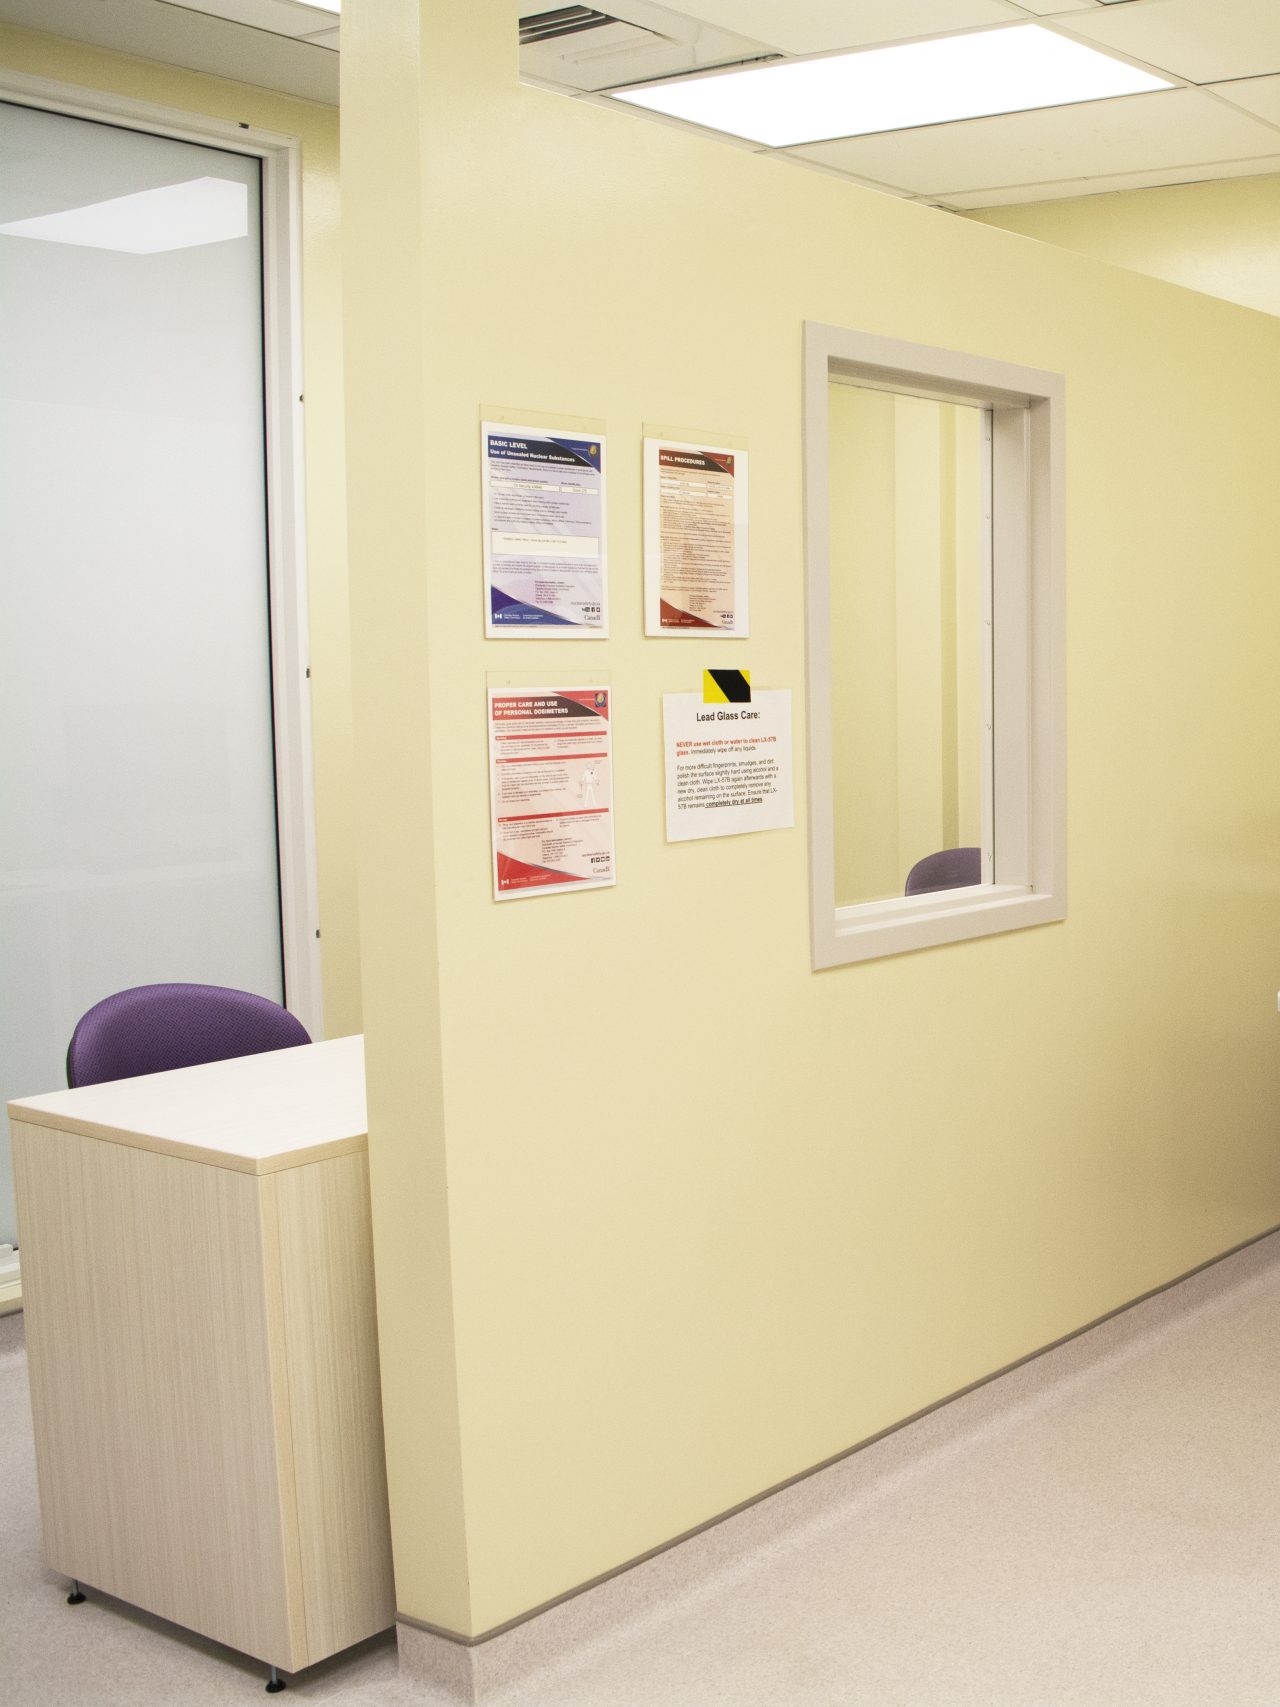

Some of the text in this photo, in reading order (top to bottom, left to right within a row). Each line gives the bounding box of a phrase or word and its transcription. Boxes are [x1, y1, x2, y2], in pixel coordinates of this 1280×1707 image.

[490, 440, 508, 448] BASIC
[675, 456, 706, 466] PROCEDURES
[696, 710, 760, 722] Lead Glass Care:
